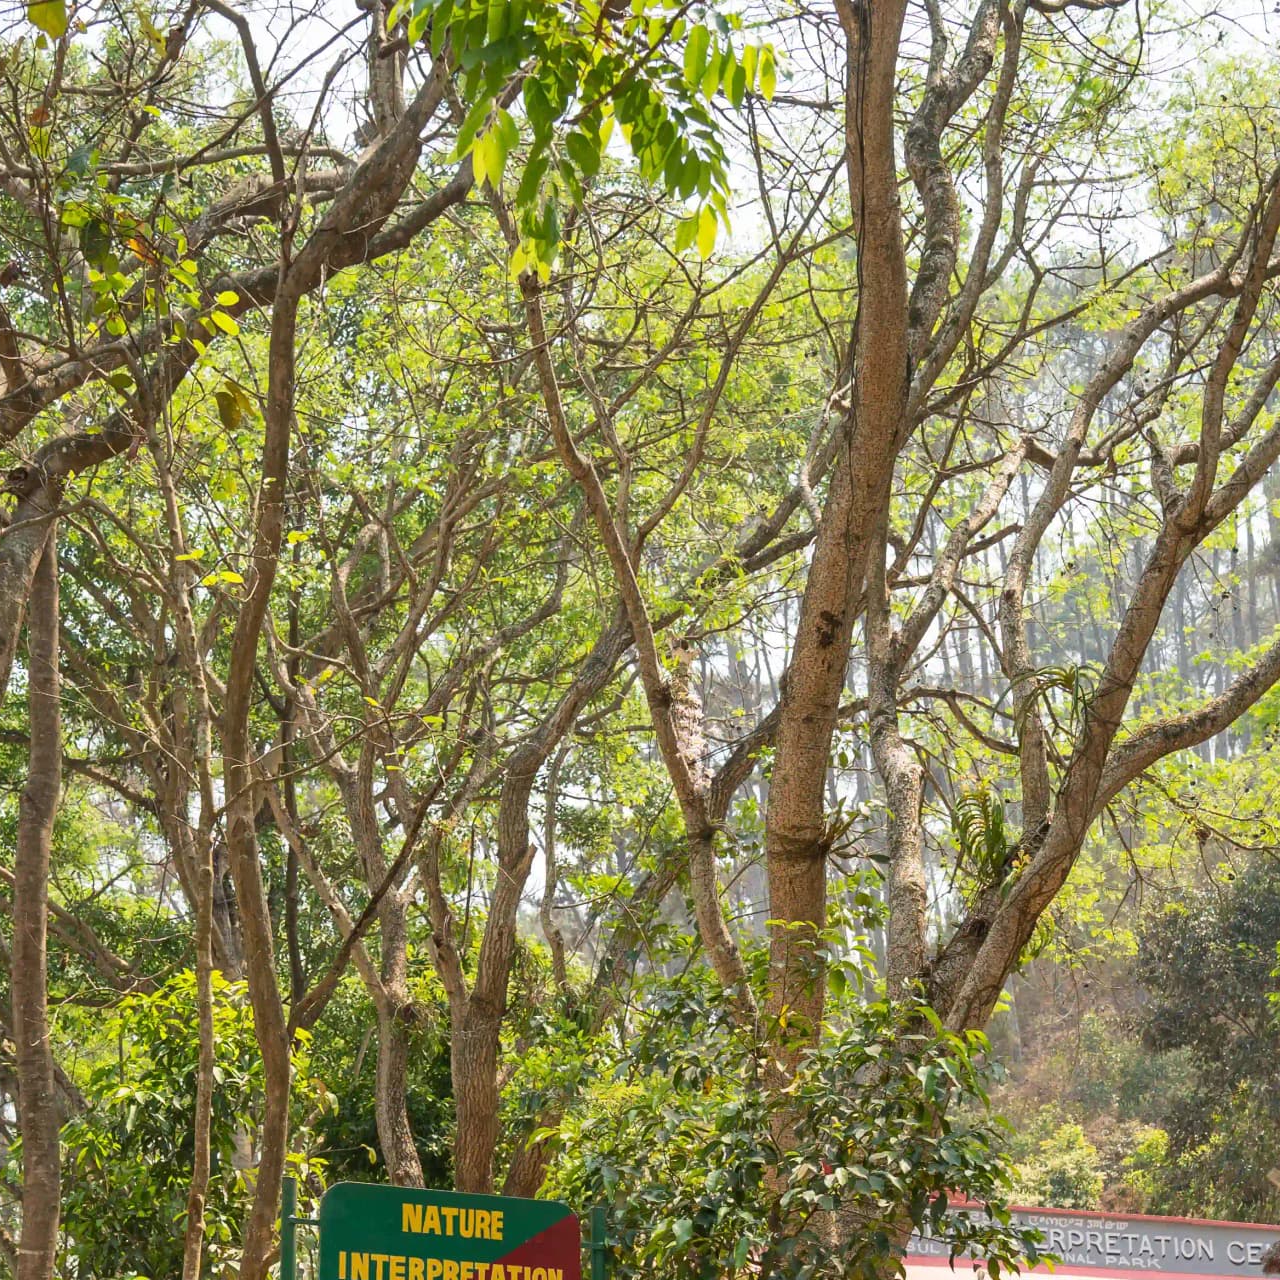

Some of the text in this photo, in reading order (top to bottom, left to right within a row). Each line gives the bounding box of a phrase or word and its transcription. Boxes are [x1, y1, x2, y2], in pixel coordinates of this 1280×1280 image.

[402, 1203, 504, 1240] NATURE
[1022, 1227, 1214, 1260] RPRETATION
[1105, 1255, 1161, 1269] PARK
